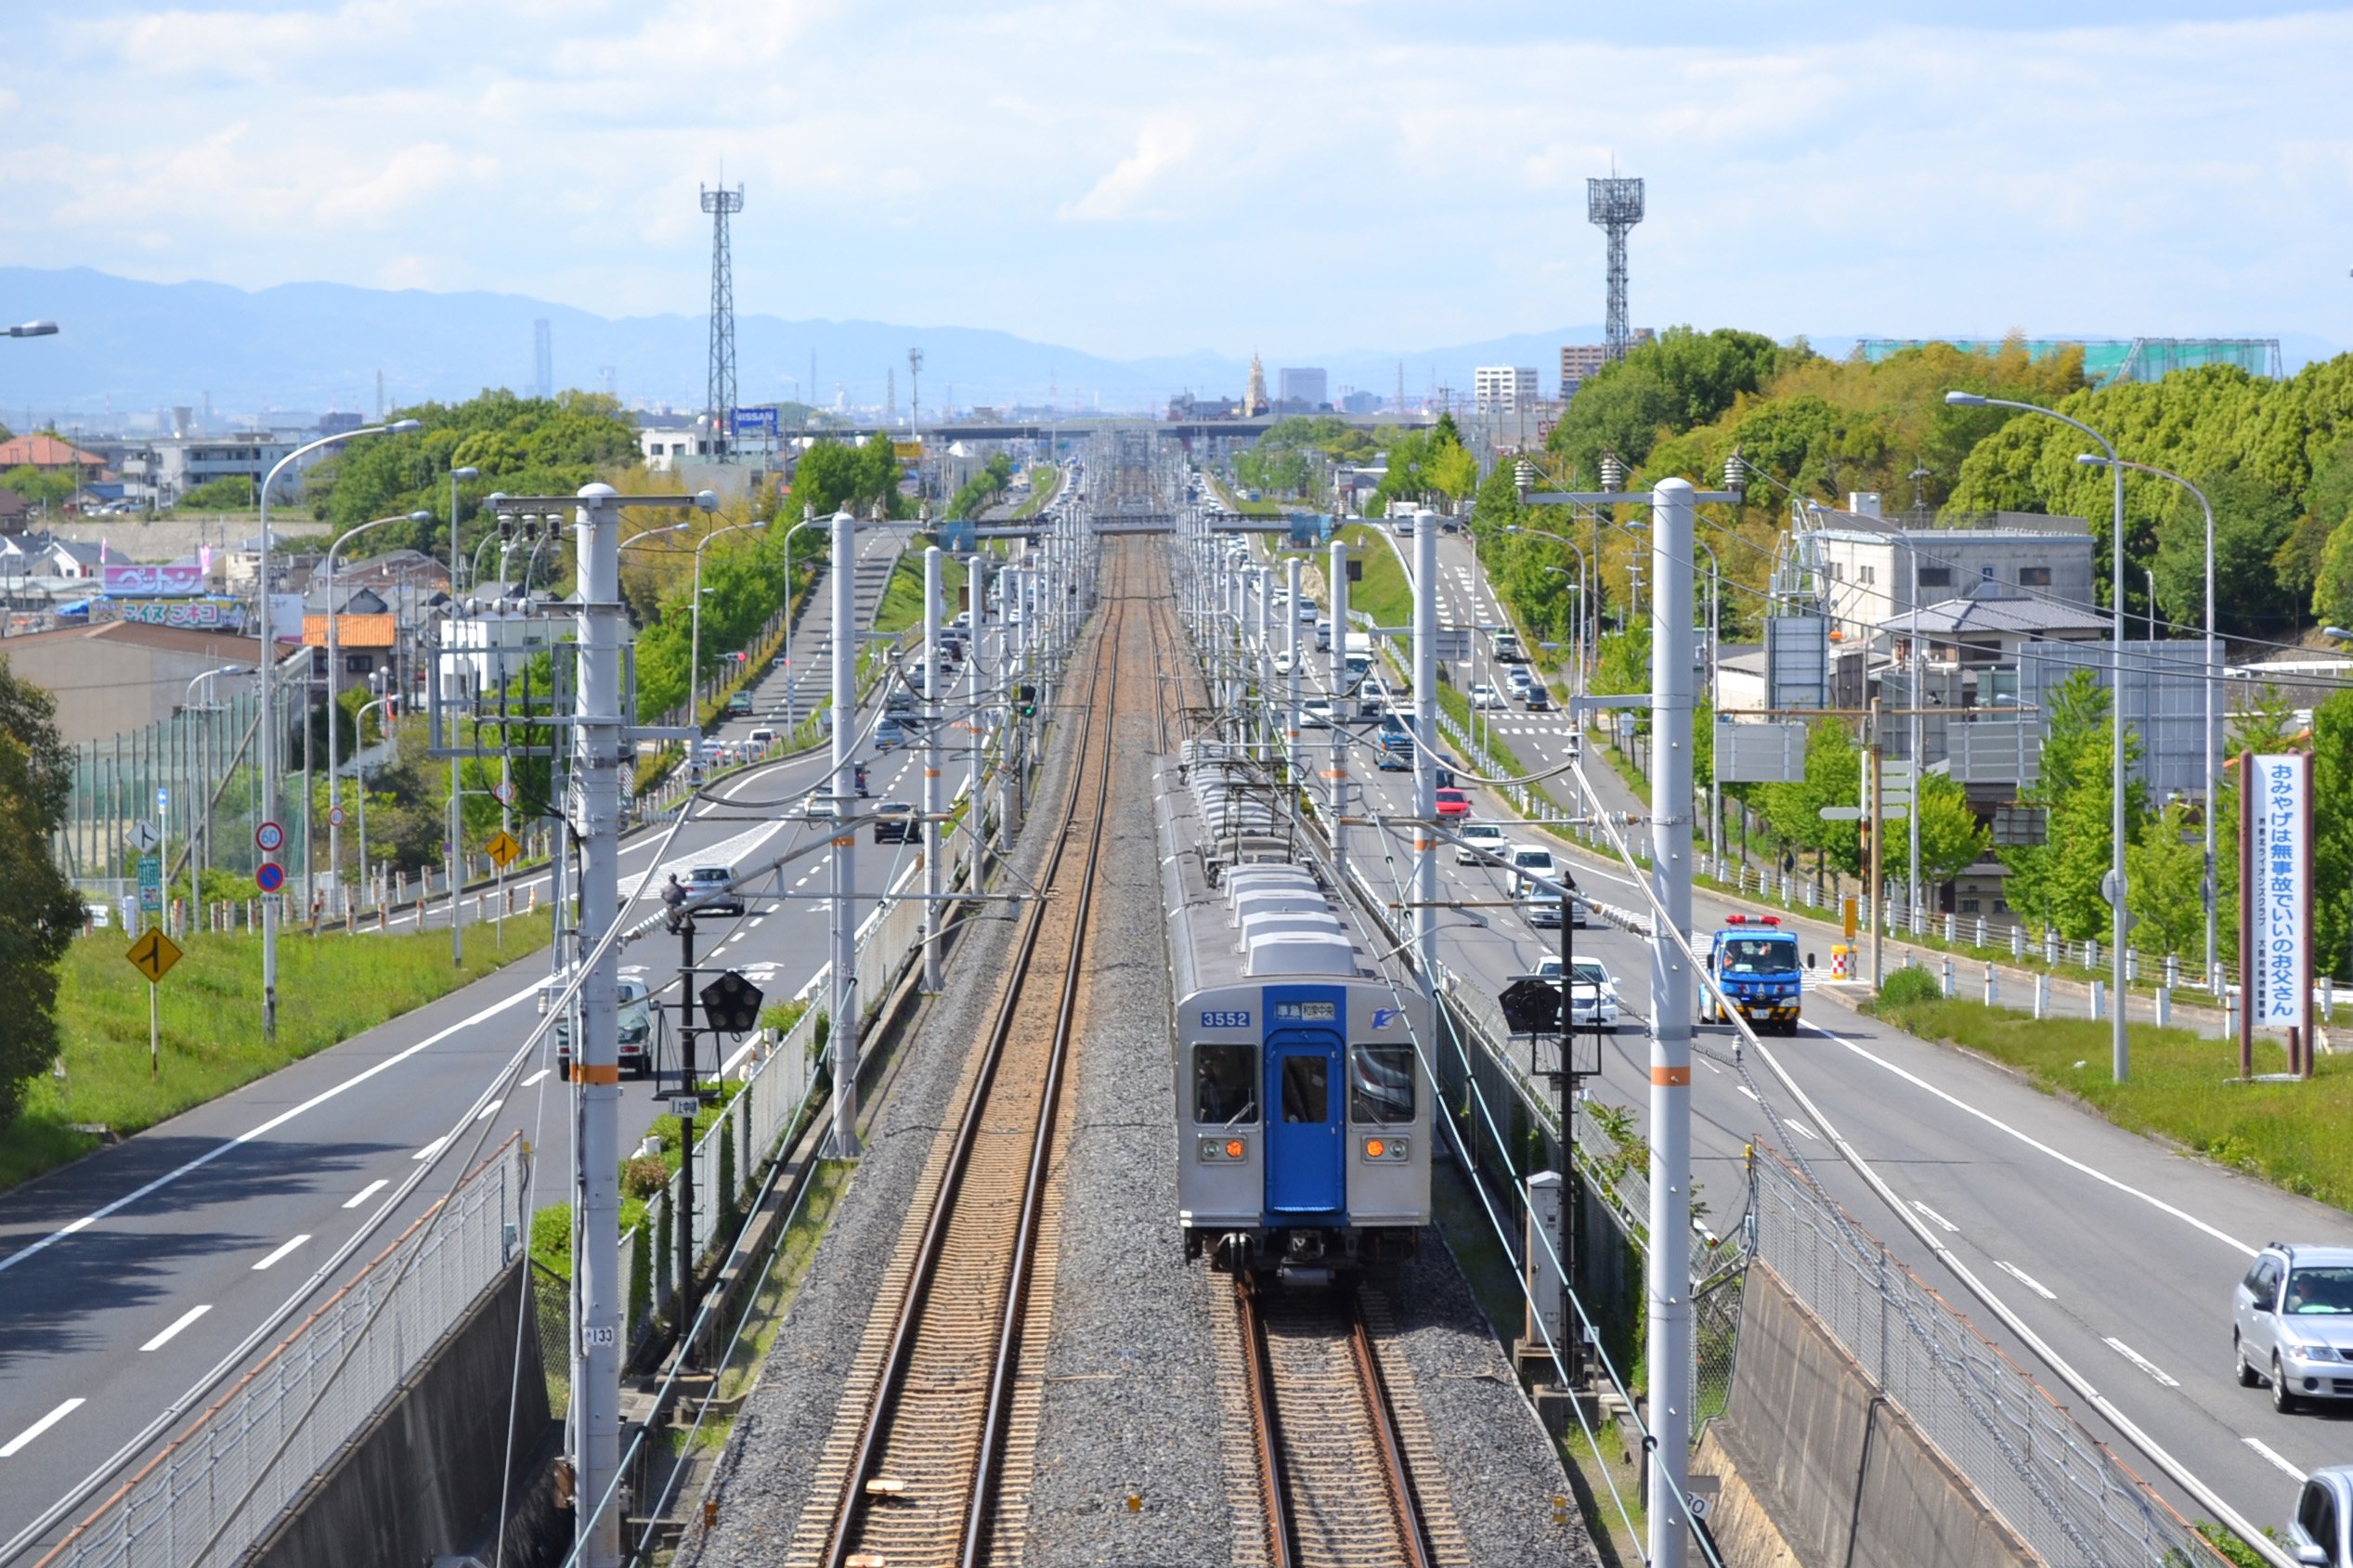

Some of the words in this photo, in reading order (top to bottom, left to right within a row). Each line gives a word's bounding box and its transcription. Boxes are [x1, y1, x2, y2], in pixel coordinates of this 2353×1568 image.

[735, 410, 774, 421] NISSAN
[261, 830, 278, 844] 60
[2270, 764, 2294, 1017] おみやげは無事故でいいのお父さん
[1203, 1013, 1247, 1027] 3552
[593, 1328, 613, 1342] 133
